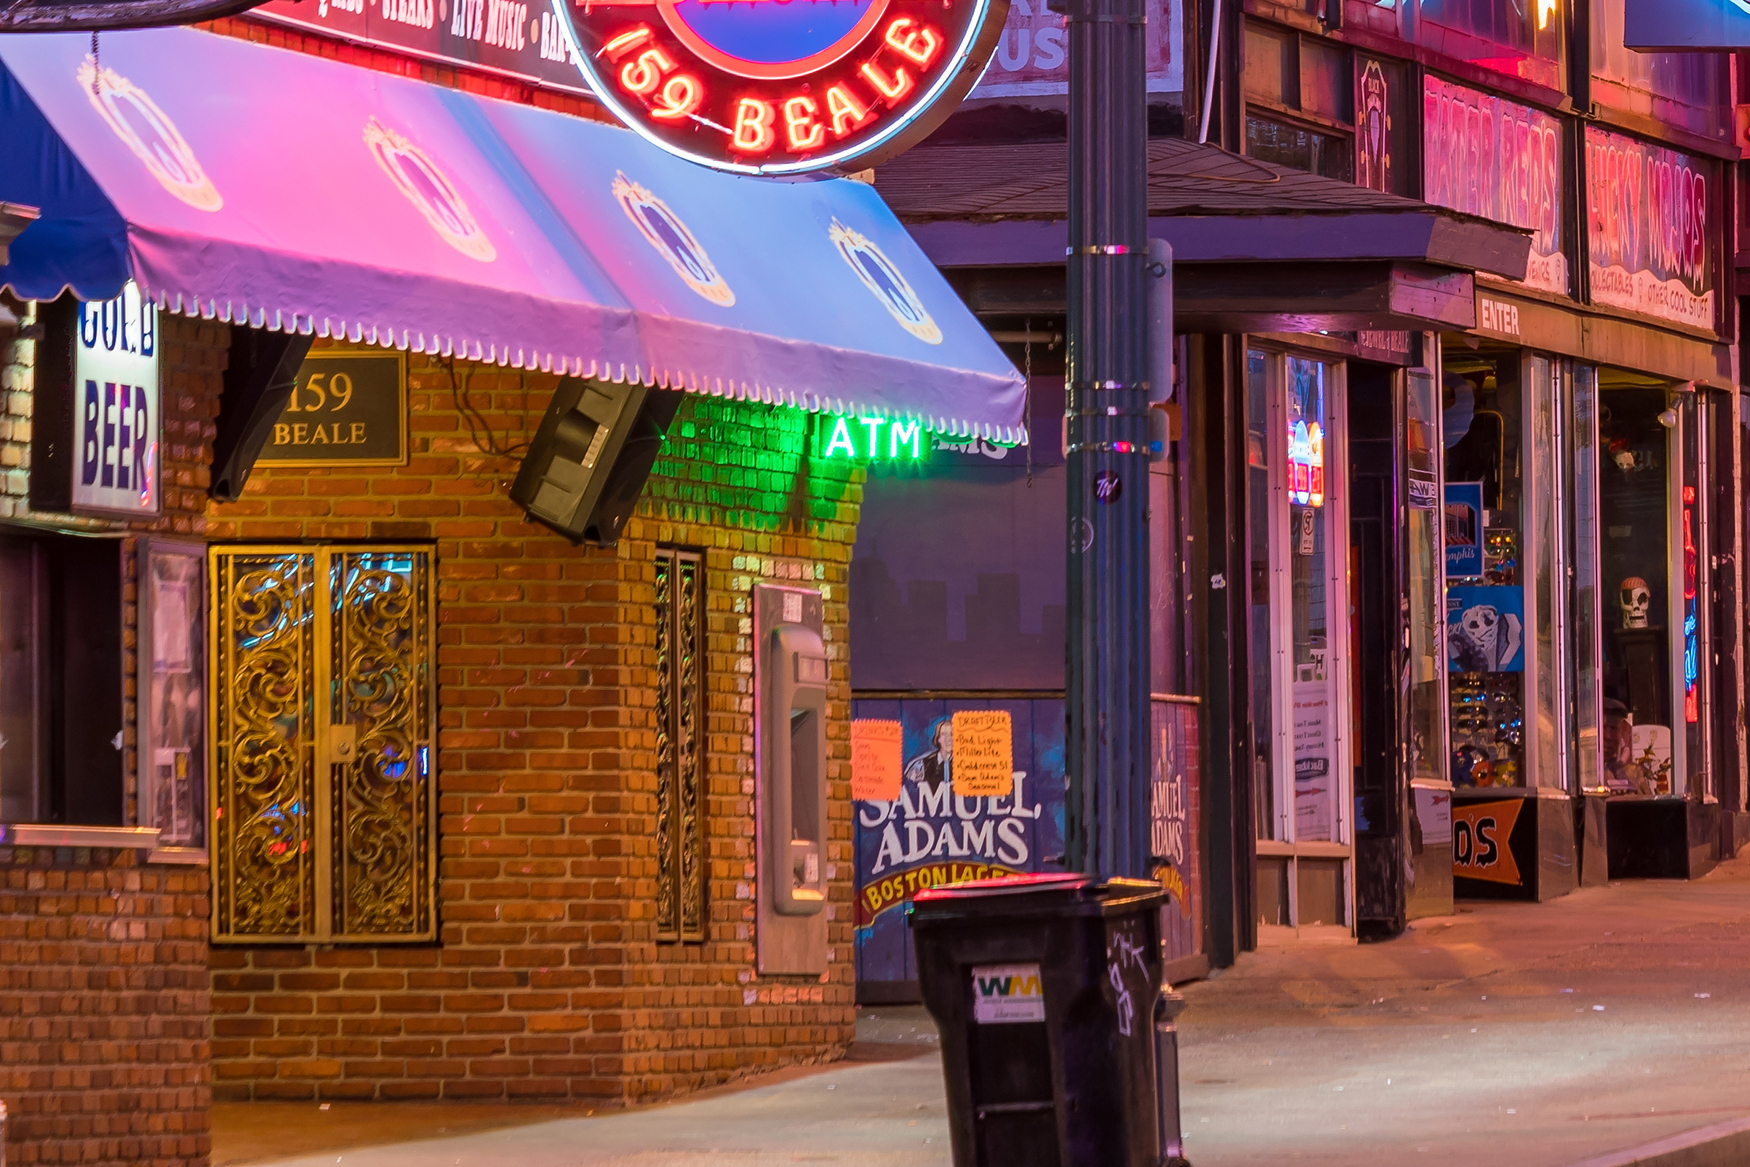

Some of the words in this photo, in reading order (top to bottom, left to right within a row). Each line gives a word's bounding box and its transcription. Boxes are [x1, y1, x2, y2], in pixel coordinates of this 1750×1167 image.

[603, 28, 701, 119] 159
[731, 16, 944, 155] BEALE
[1481, 298, 1520, 336] ENTER
[1591, 270, 1634, 299] OLLECTABLES
[1647, 283, 1669, 307] OTHER
[1669, 289, 1687, 313] COOL
[1689, 296, 1708, 321] STUFF
[288, 373, 353, 413] 159
[82, 379, 149, 491] BEER
[273, 422, 367, 446] BEALE
[825, 416, 920, 459] ATM
[1152, 774, 1186, 822] AMUEL
[872, 817, 1029, 875] ADAMS
[866, 865, 947, 911] BOSTON
[979, 976, 1043, 996] WM
